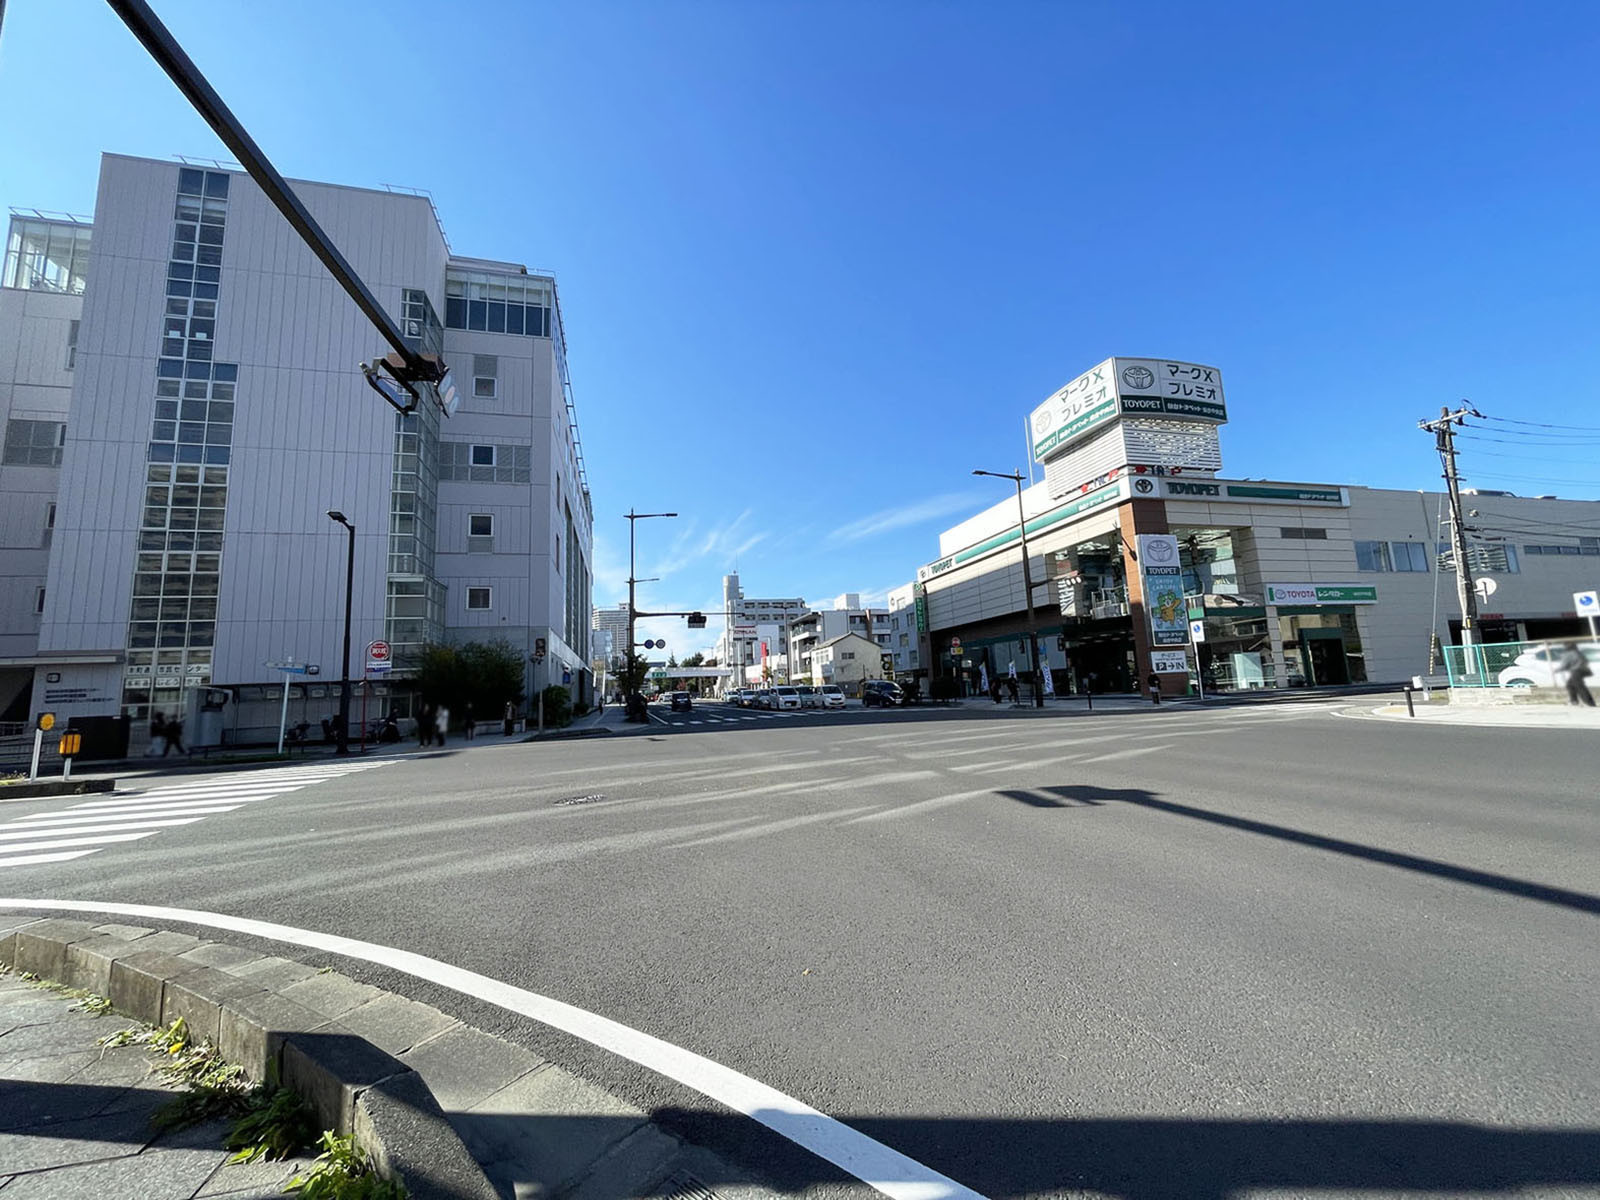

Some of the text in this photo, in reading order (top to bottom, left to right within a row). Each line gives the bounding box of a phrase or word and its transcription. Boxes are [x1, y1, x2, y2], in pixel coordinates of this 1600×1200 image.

[1167, 364, 1213, 383] マークX
[1059, 368, 1104, 403] マークX
[1122, 400, 1160, 409] TOYOPET
[1166, 482, 1221, 496] TOYOPET
[1149, 567, 1177, 575] TOYOPET
[1287, 590, 1316, 598] TOYOTA
